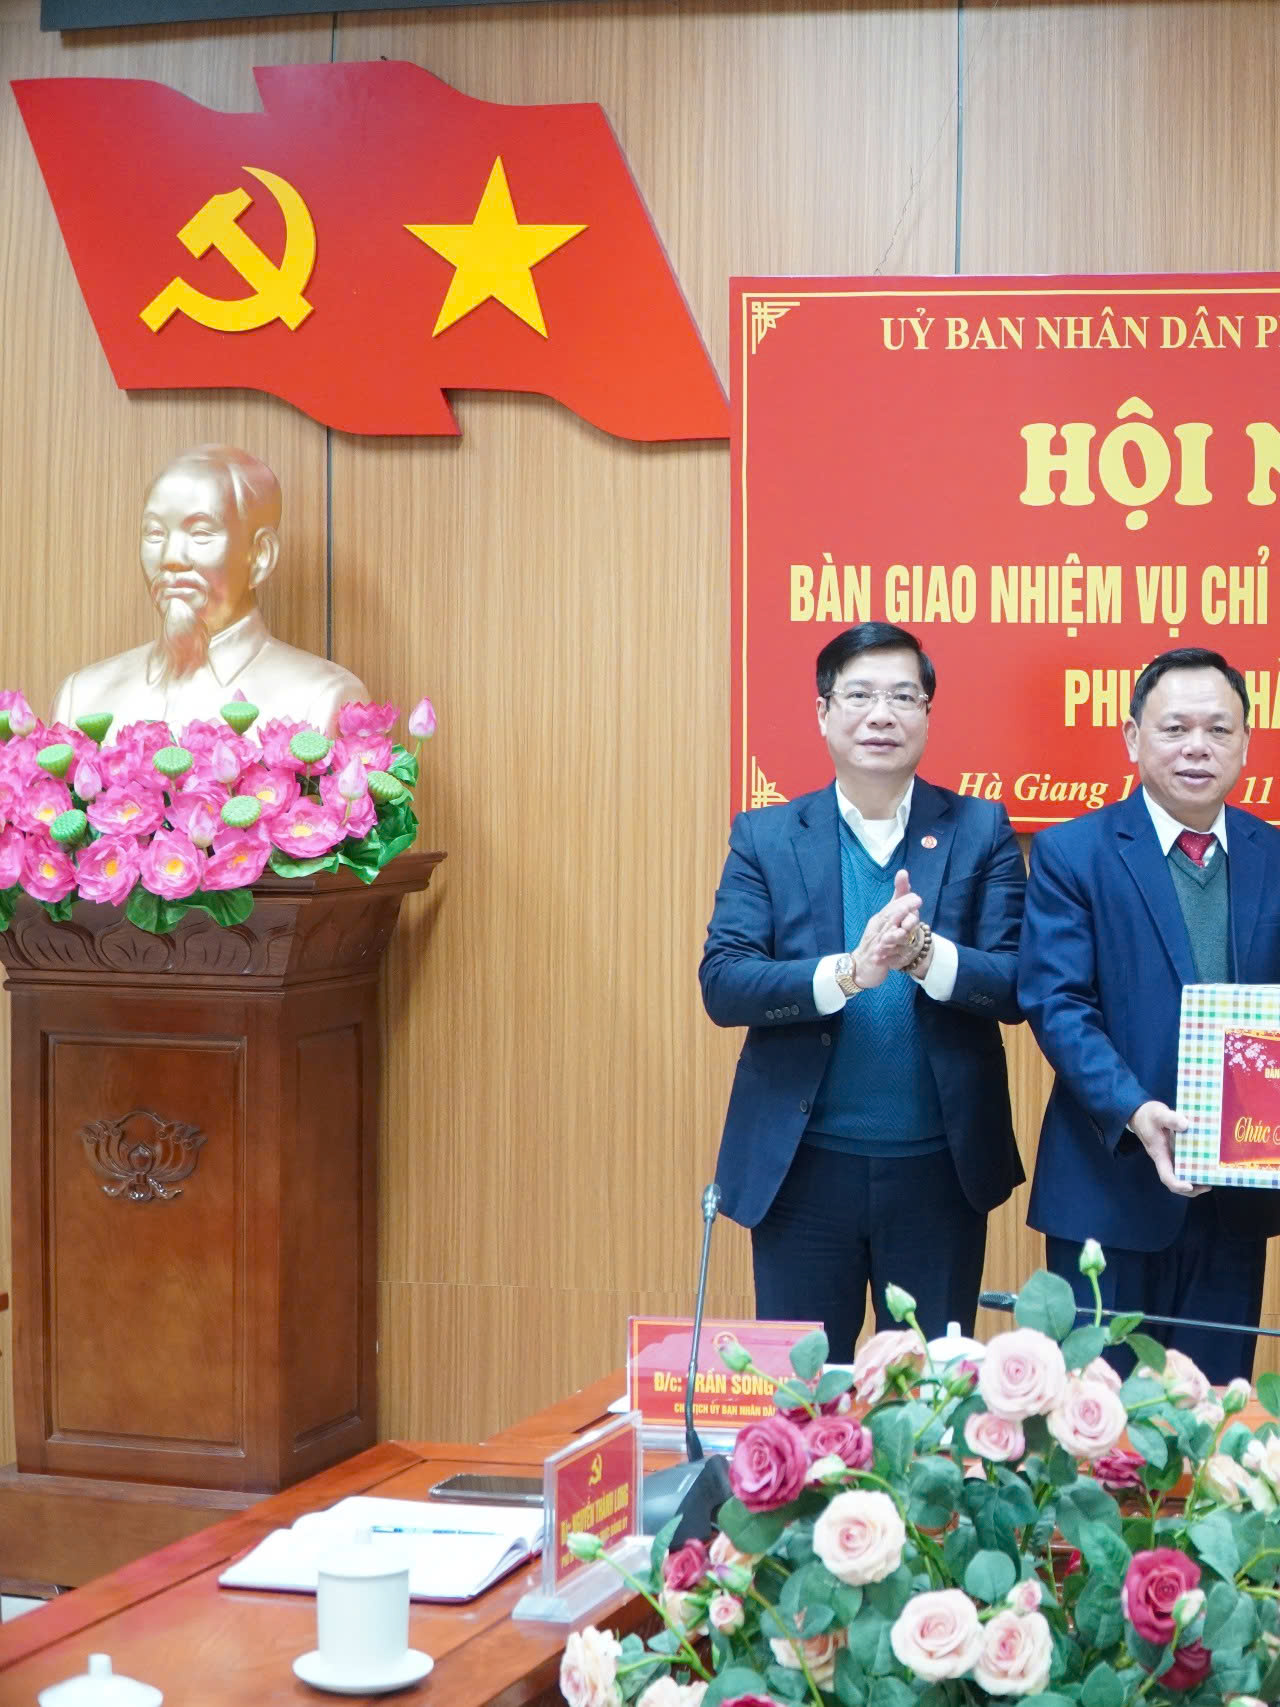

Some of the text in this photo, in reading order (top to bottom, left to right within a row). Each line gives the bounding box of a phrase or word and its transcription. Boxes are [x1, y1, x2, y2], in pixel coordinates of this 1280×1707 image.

[880, 307, 935, 350] UỶ
[945, 316, 1025, 350] BAN
[1036, 306, 1150, 350] NHÂN
[1160, 305, 1244, 349] DÂN
[1019, 396, 1214, 531] HỘI
[790, 552, 871, 624] BÀN
[885, 564, 977, 624] GIAO
[990, 553, 1123, 638] NHIỆM
[1135, 565, 1188, 638] VỤ
[1201, 546, 1270, 626] CHỈ
[958, 772, 1003, 800] Hà
[1013, 773, 1109, 810] Giang
[1239, 776, 1274, 804] 11
[1234, 1116, 1271, 1143] Chúc
[686, 1367, 727, 1394] RẦN
[730, 1372, 774, 1396] SONG
[673, 1402, 686, 1414] CH
